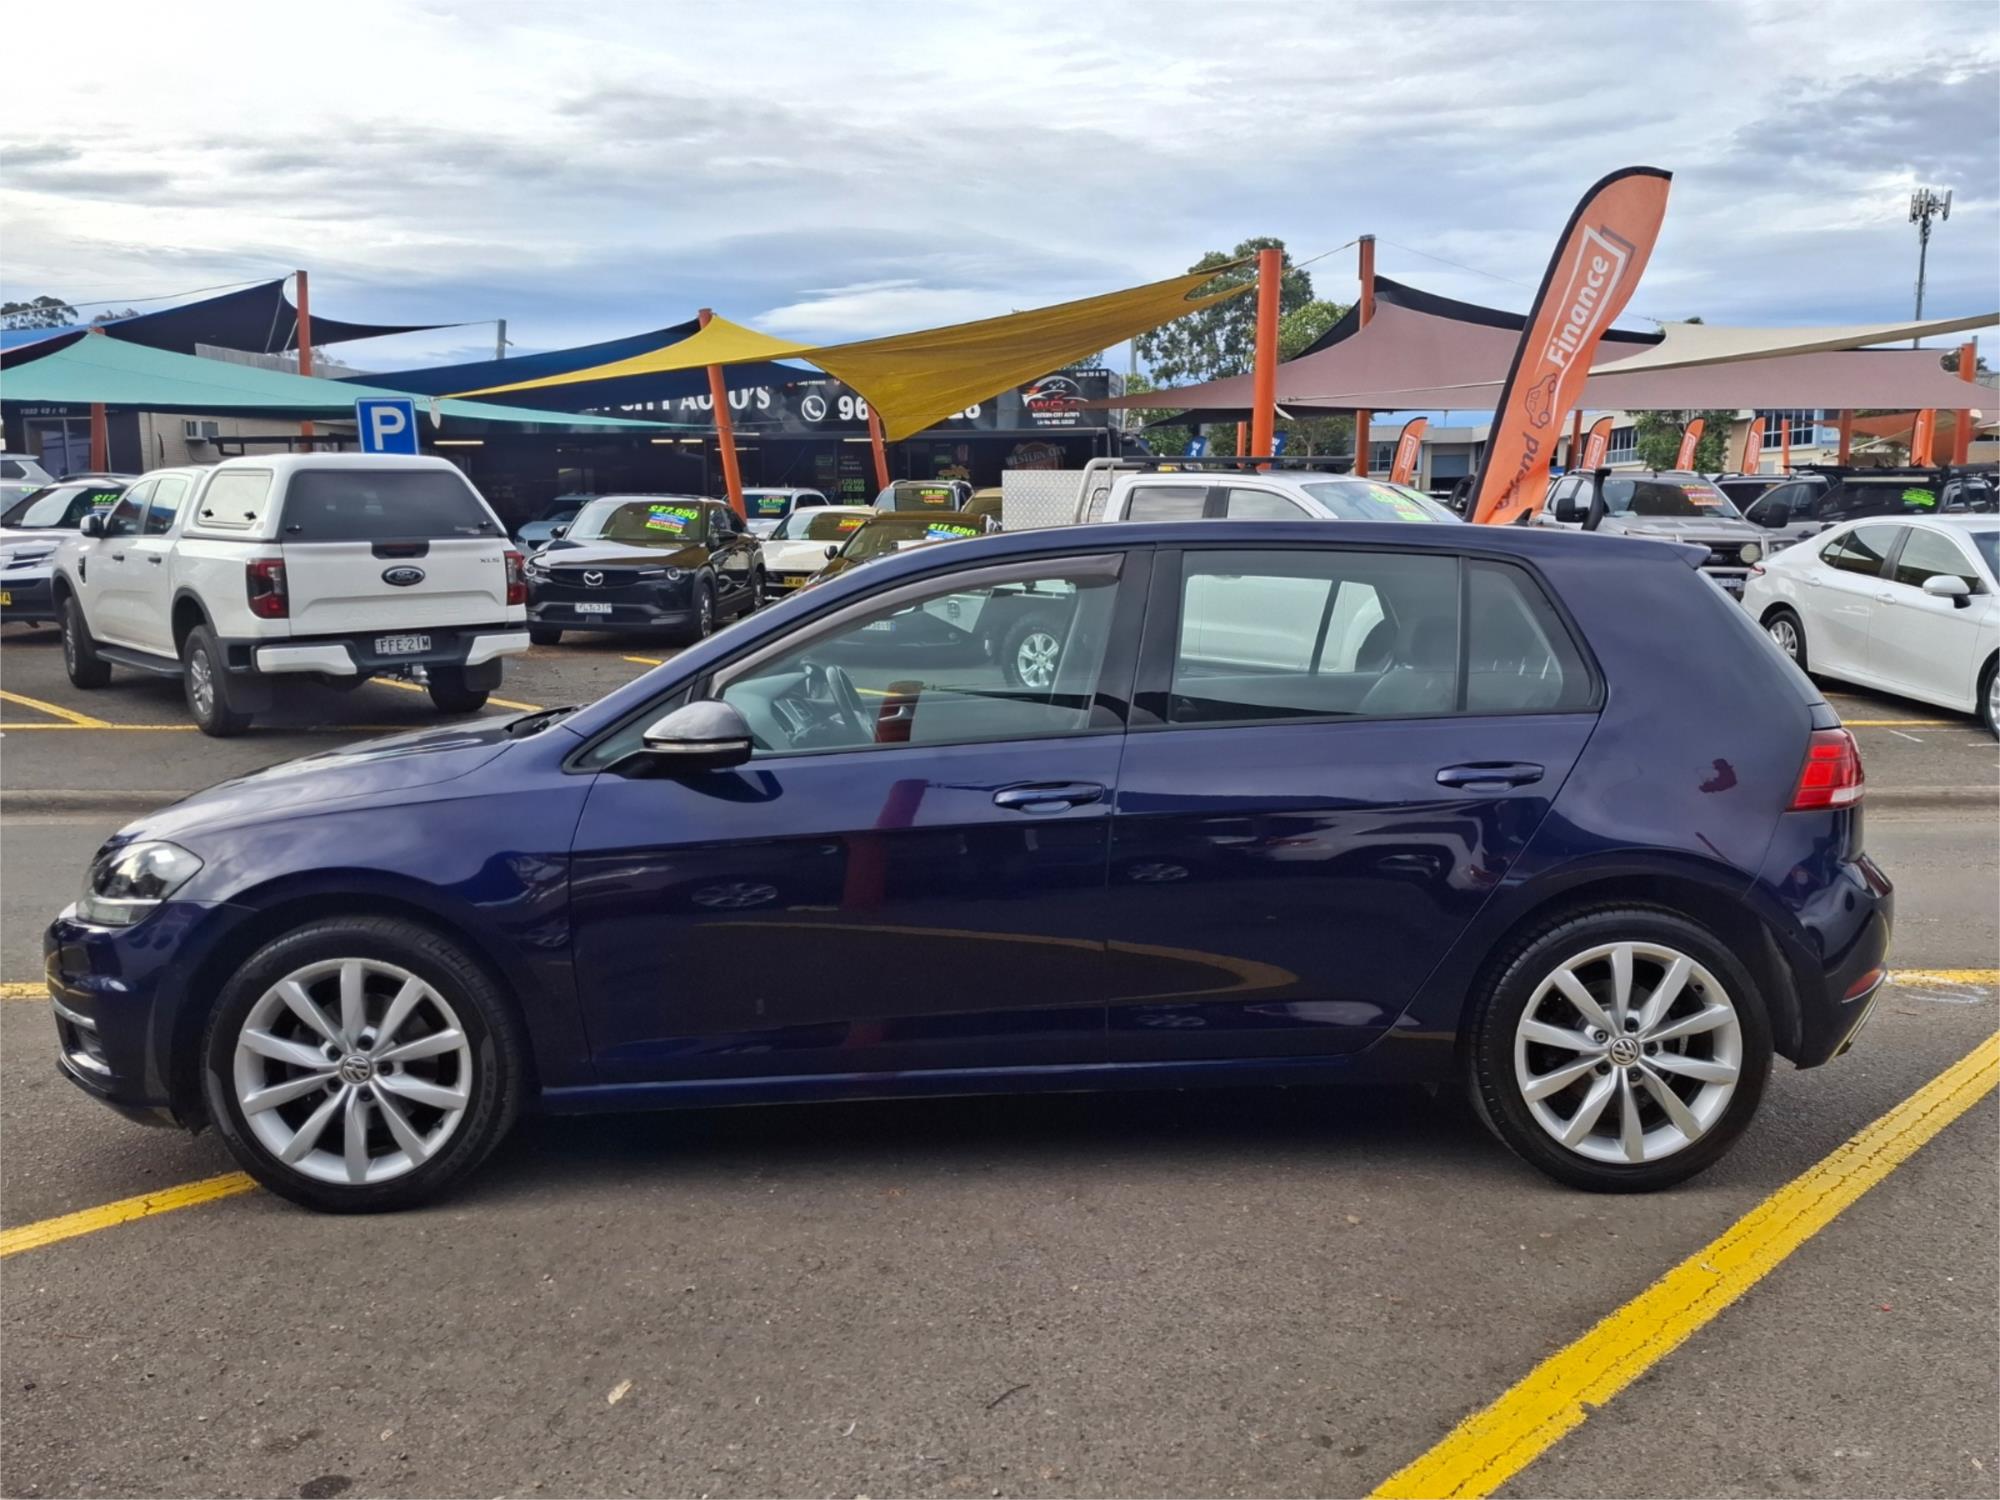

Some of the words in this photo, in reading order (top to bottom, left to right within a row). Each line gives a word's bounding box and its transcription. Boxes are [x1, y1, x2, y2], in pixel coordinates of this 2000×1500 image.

[1546, 254, 1610, 369] Finance
[371, 406, 406, 451] P
[838, 395, 869, 421] 96
